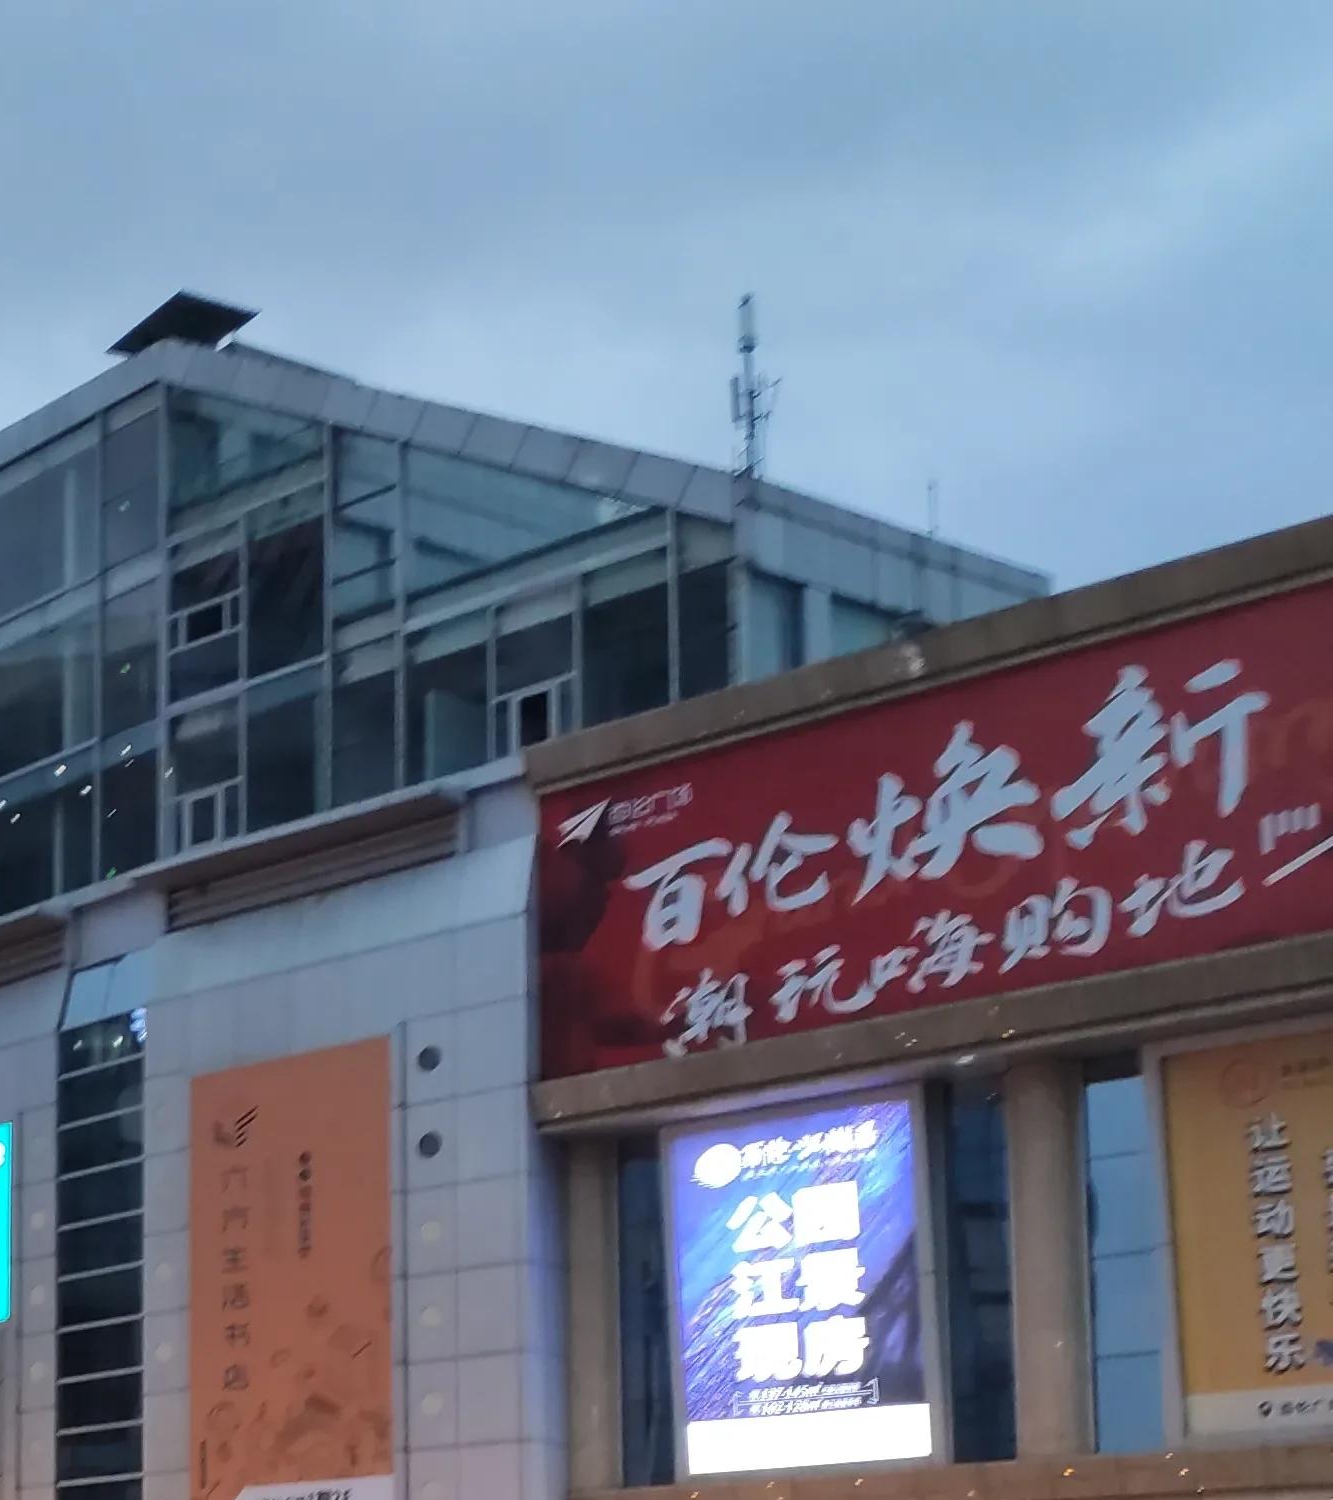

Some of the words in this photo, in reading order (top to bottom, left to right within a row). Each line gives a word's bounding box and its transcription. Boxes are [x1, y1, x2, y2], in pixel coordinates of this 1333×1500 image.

[725, 1179, 862, 1254] 公园
[1247, 1111, 1305, 1375] 让运动更快乐
[731, 1247, 866, 1321] 江景
